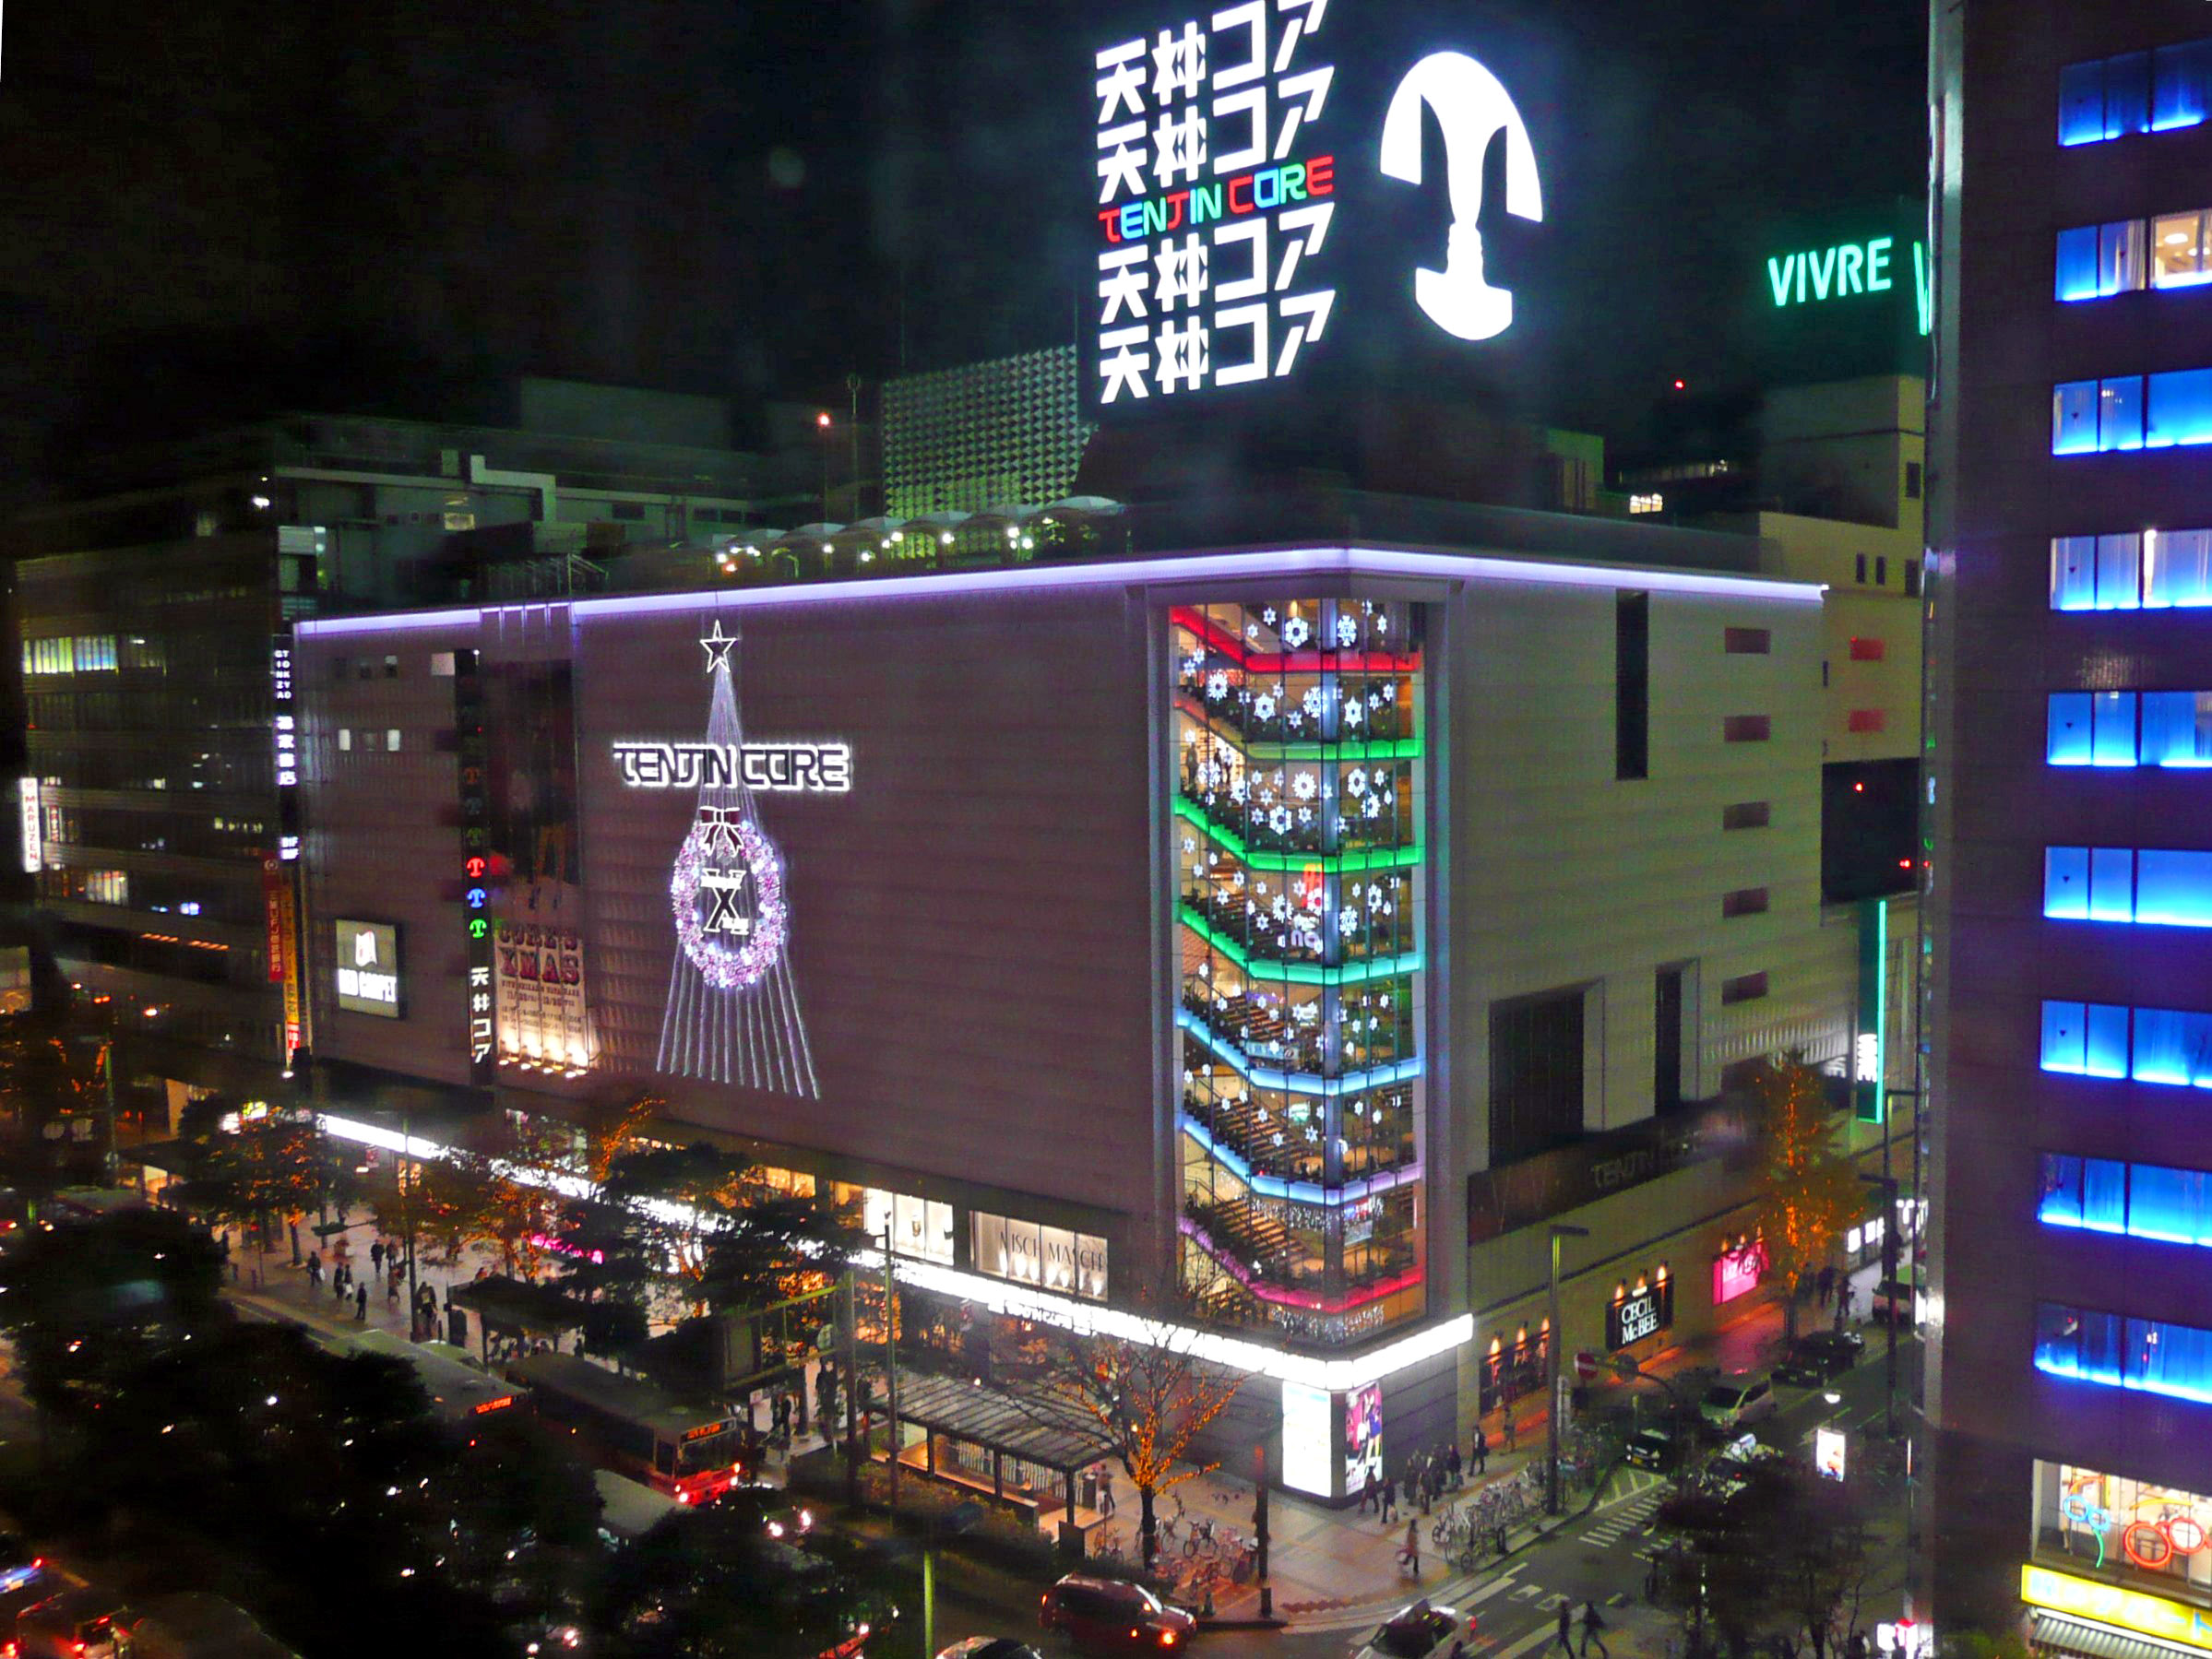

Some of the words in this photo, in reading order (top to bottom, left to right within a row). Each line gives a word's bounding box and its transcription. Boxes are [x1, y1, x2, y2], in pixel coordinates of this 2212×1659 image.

[1096, 0, 1328, 124] 天神コア
[1097, 65, 1335, 204] 天神コア
[1098, 183, 1222, 243] TENJIN
[1228, 155, 1334, 214] CORE
[1099, 202, 1336, 325] 天神コア
[1767, 236, 1892, 306] VIVRE
[1100, 289, 1337, 404] 天神コア
[612, 741, 738, 789] TENJIN
[740, 742, 851, 791] CORE
[25, 795, 39, 860] MARUZEN
[1622, 1296, 1656, 1324] CECIL
